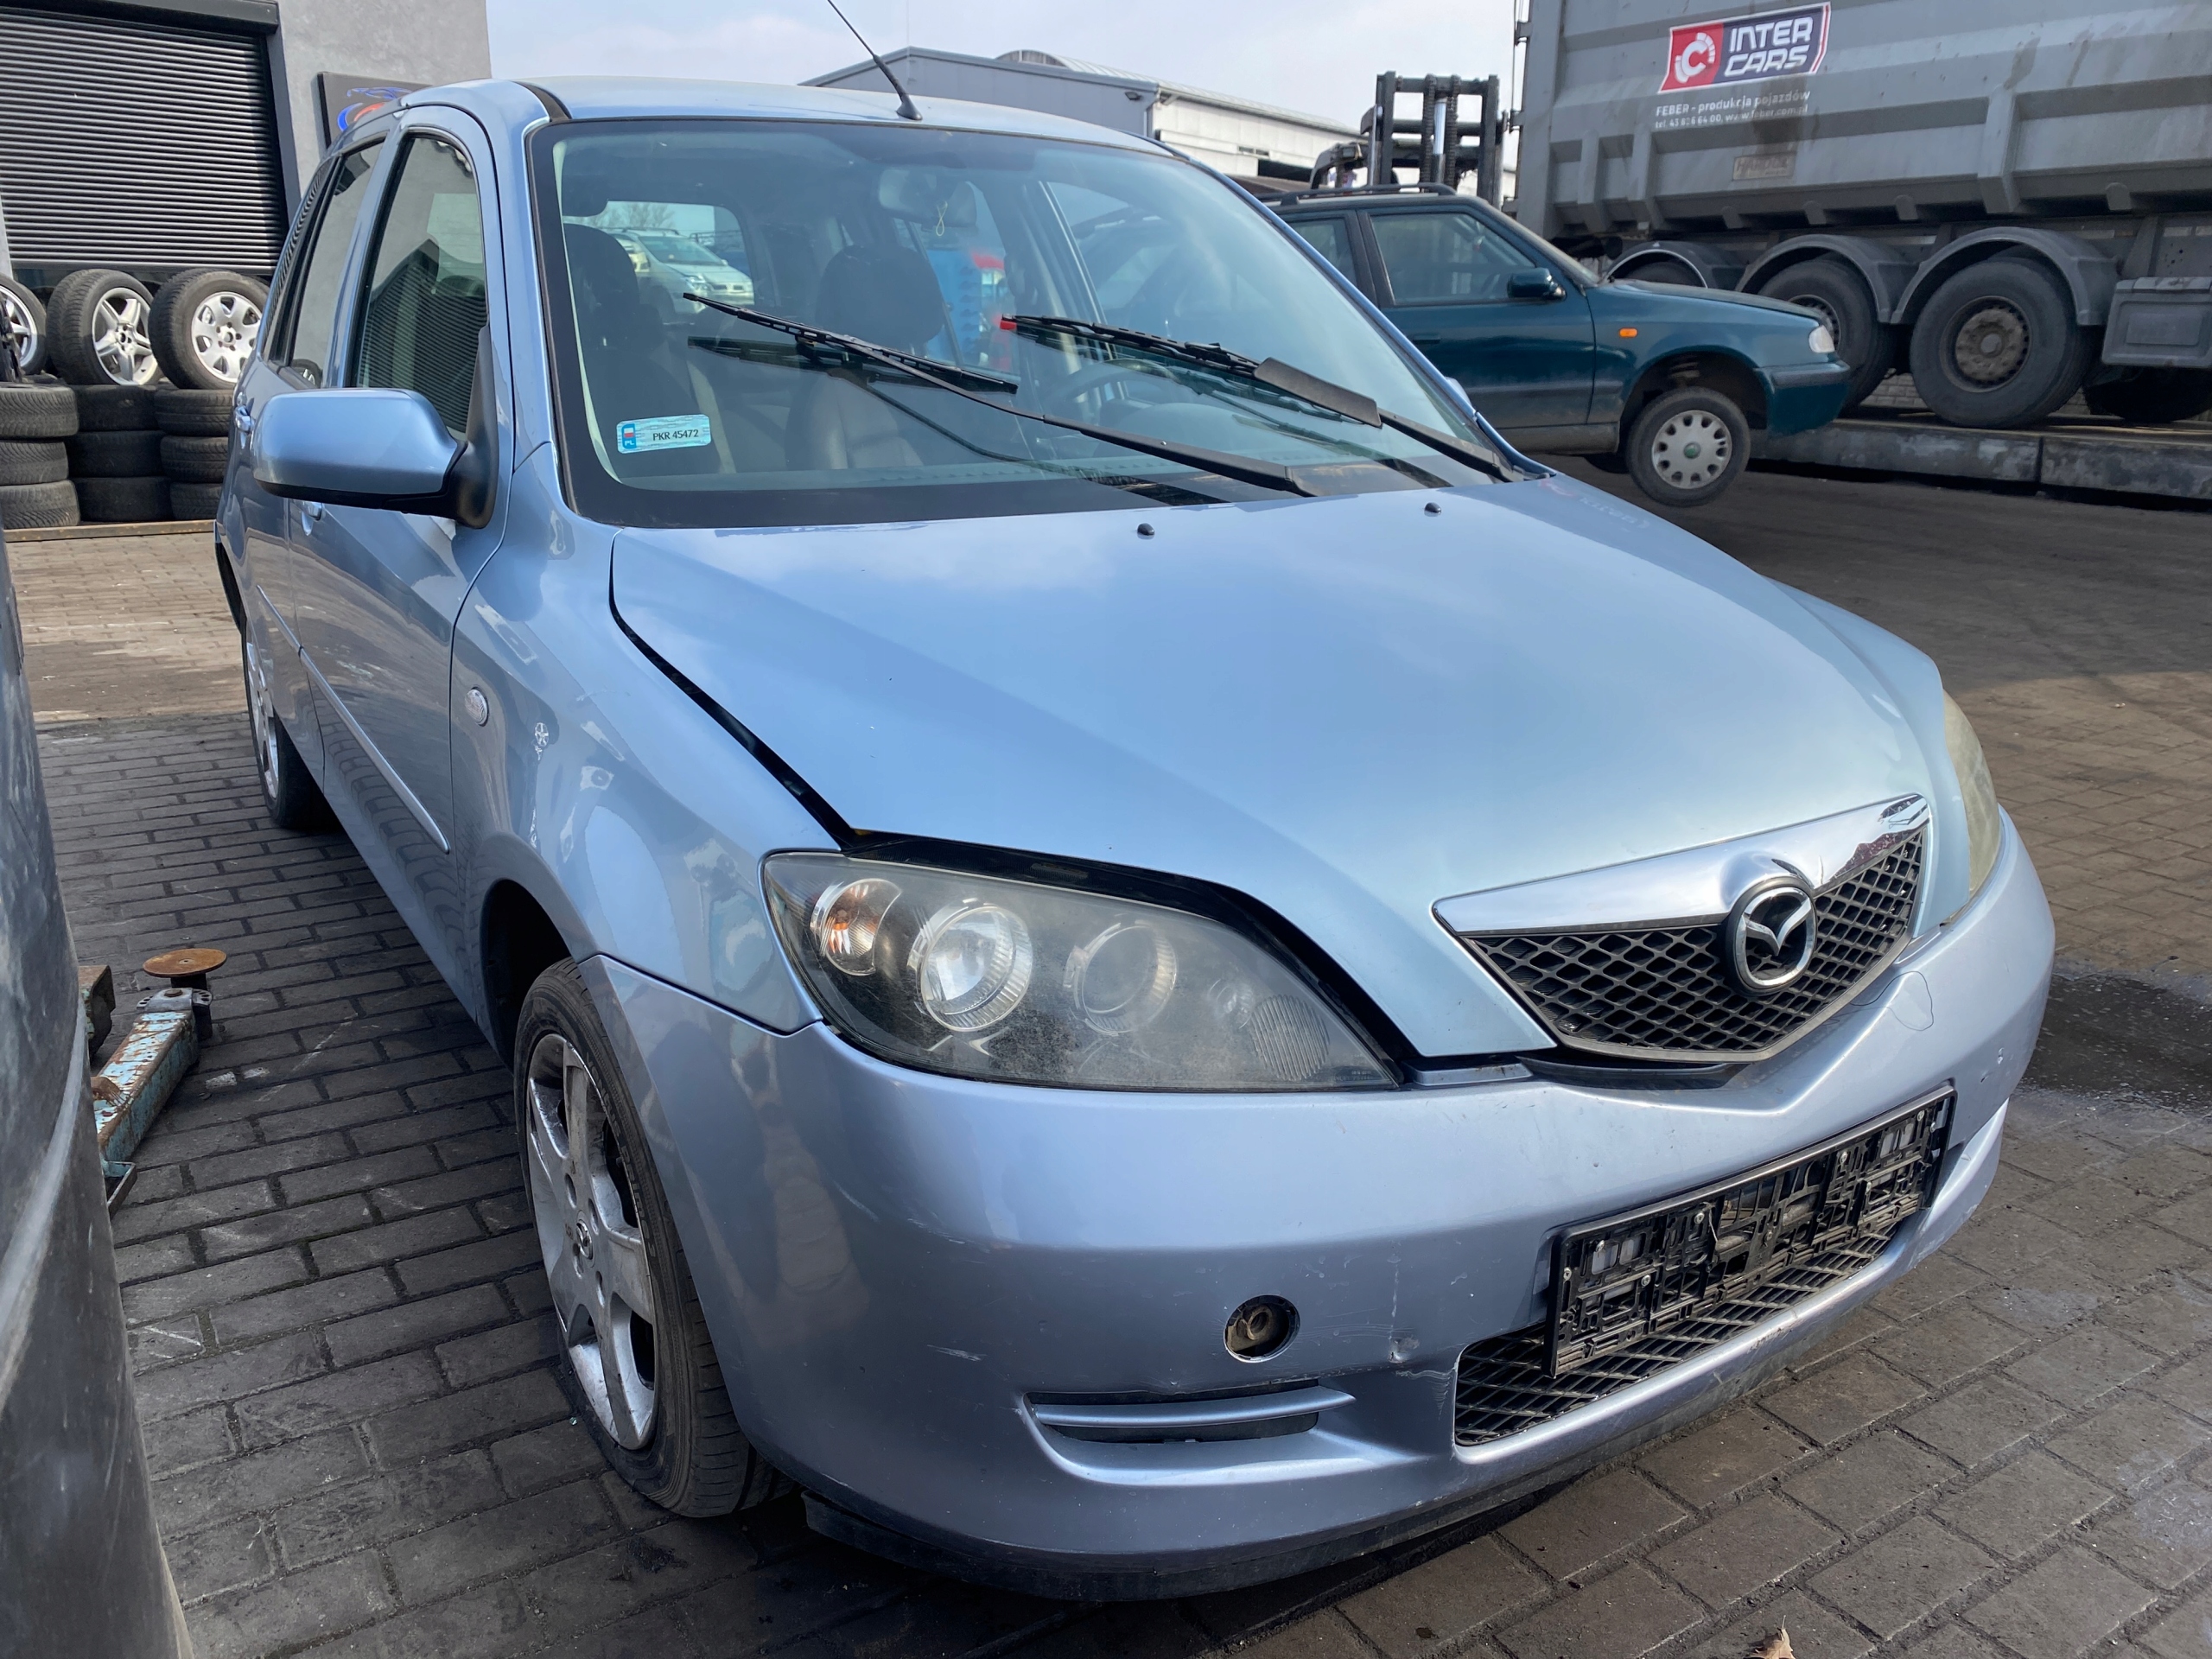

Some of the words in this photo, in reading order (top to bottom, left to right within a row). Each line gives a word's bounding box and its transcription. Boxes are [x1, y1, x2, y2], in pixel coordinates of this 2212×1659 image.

[1729, 16, 1814, 53] INTER
[1724, 45, 1810, 77] CARS
[1655, 104, 1690, 117] FEBER
[1698, 95, 1752, 114] produkcja
[1754, 89, 1811, 108] pojazdów
[652, 431, 671, 442] PKR
[671, 429, 699, 439] 45472
